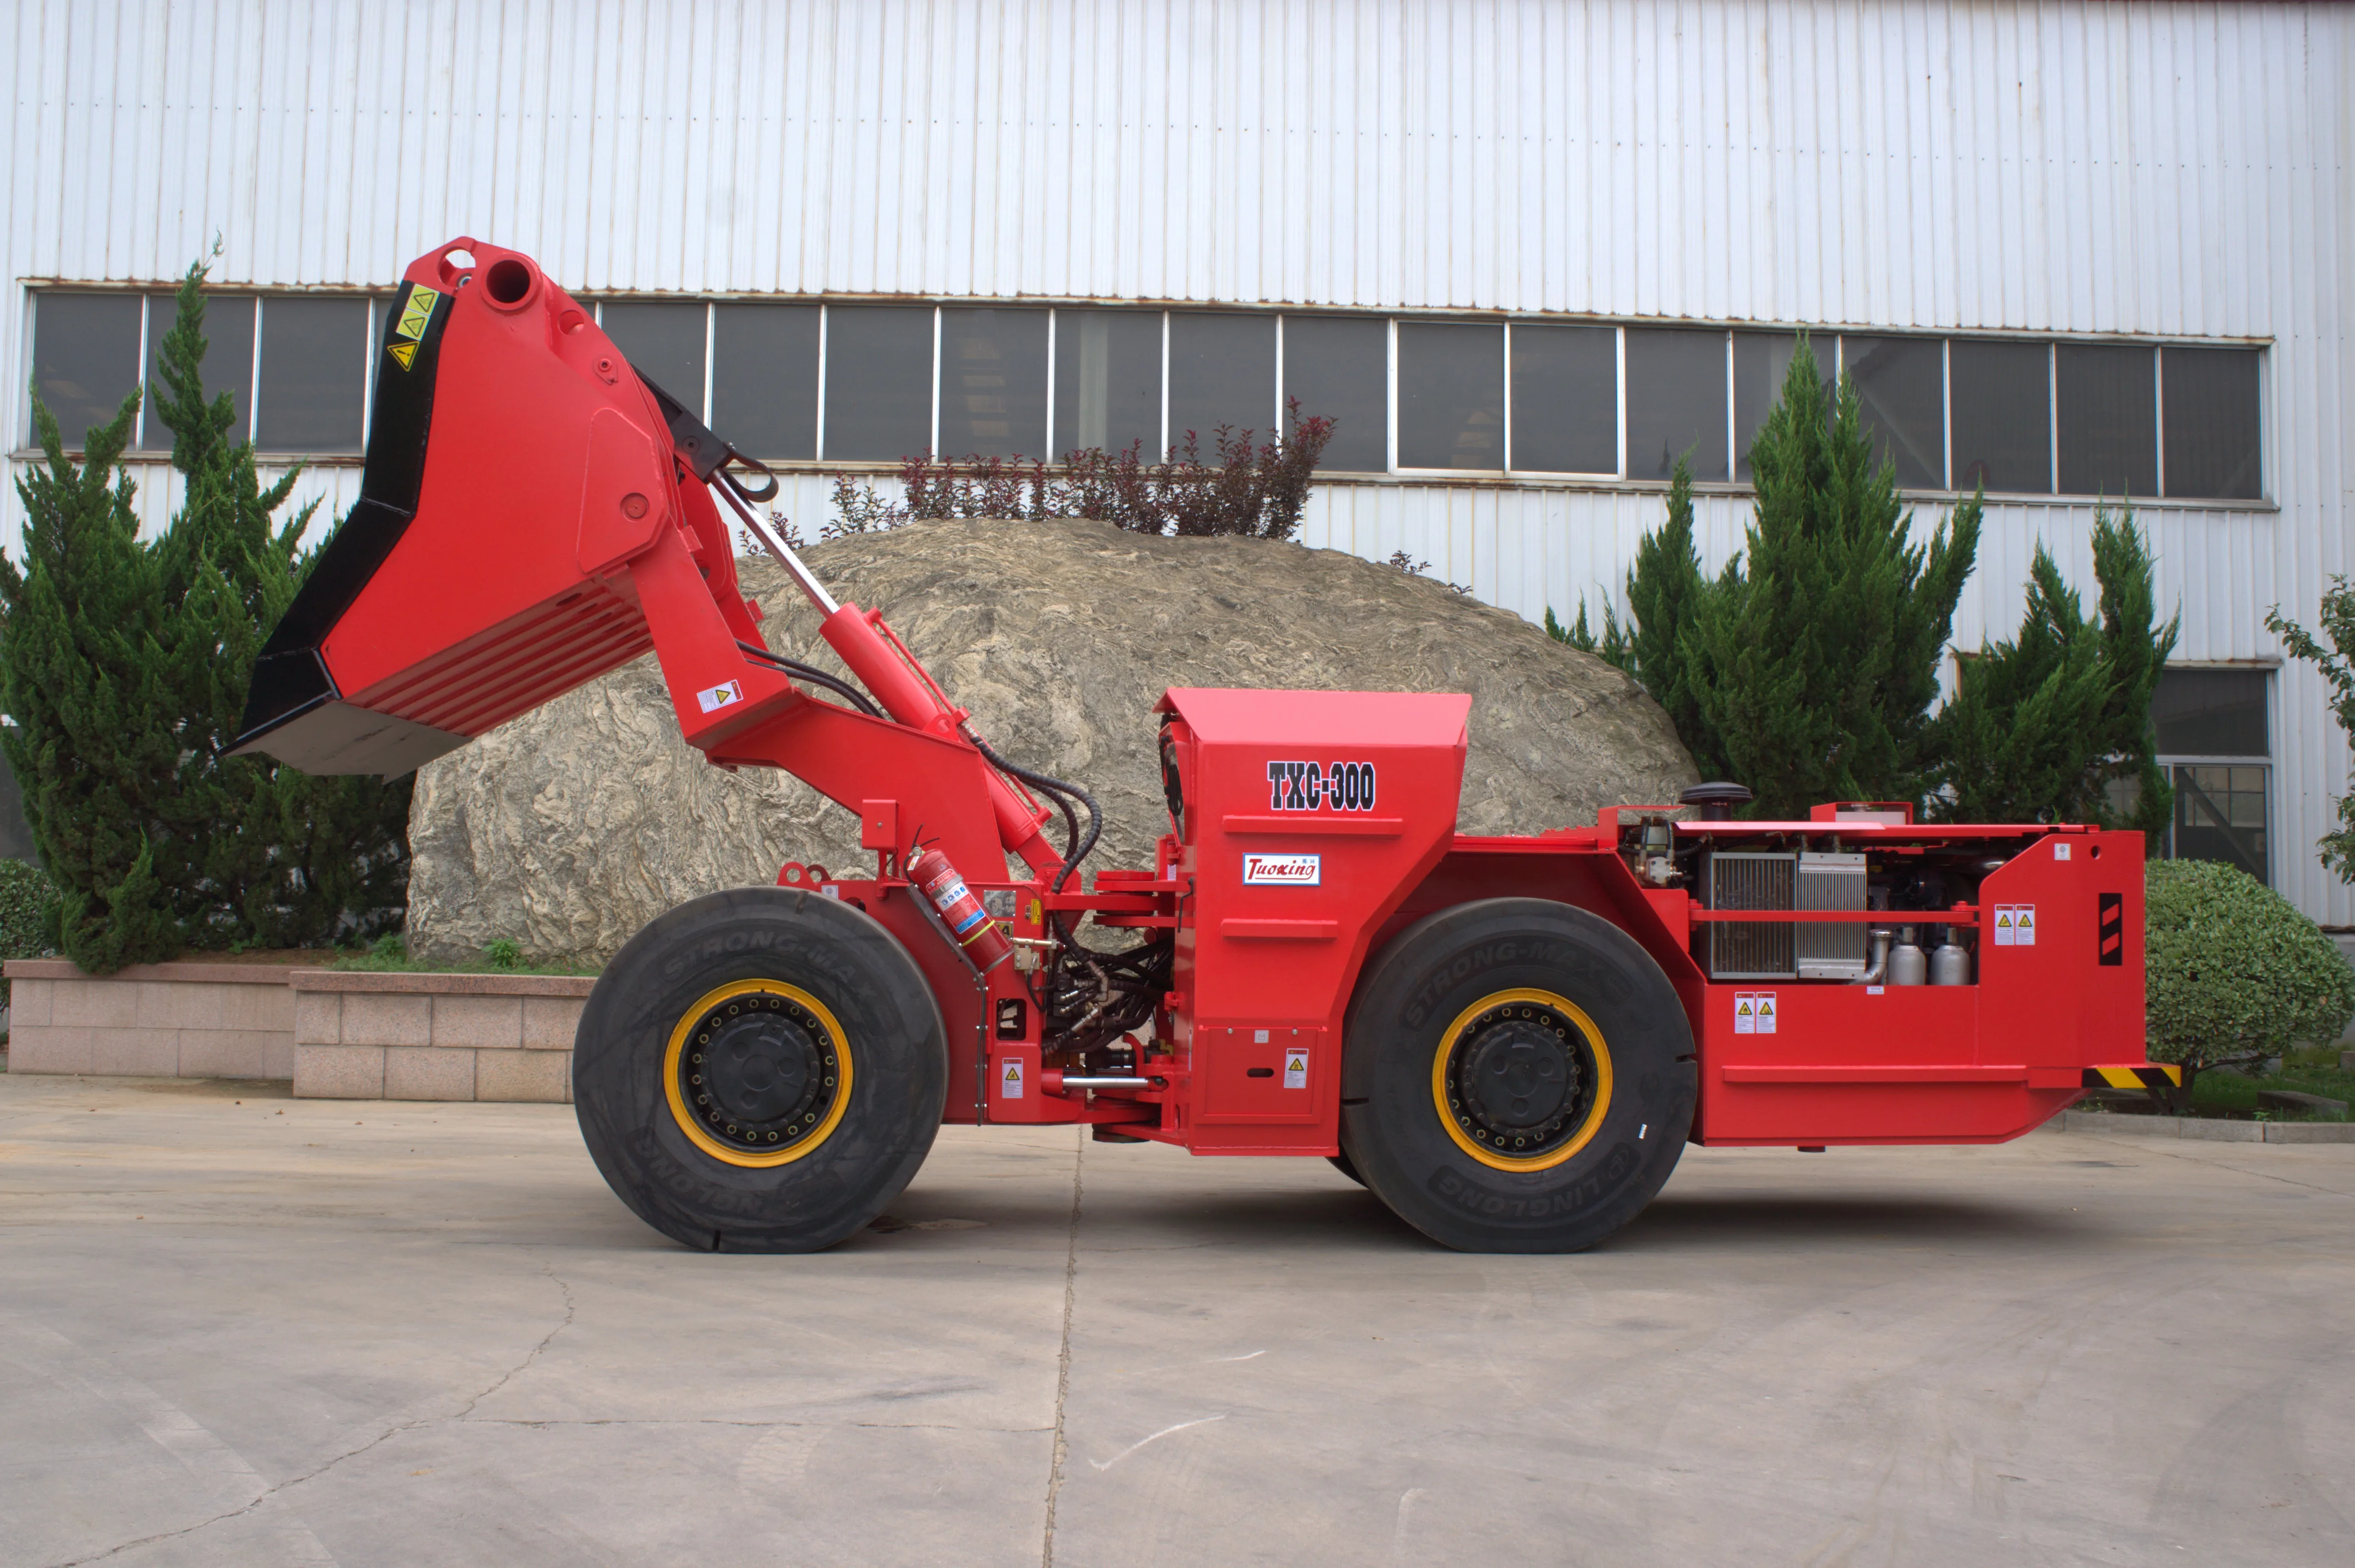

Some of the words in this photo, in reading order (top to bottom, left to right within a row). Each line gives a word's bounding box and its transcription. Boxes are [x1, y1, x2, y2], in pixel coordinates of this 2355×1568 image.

[1267, 761, 1375, 811] TXC-300
[1248, 859, 1316, 880] Tuoxing
[664, 930, 878, 1002] STRONG-MAX
[1405, 941, 1606, 1027] STRONG-MAX
[634, 1135, 789, 1215] NGLONG
[1438, 1175, 1601, 1217] LINGLONG
